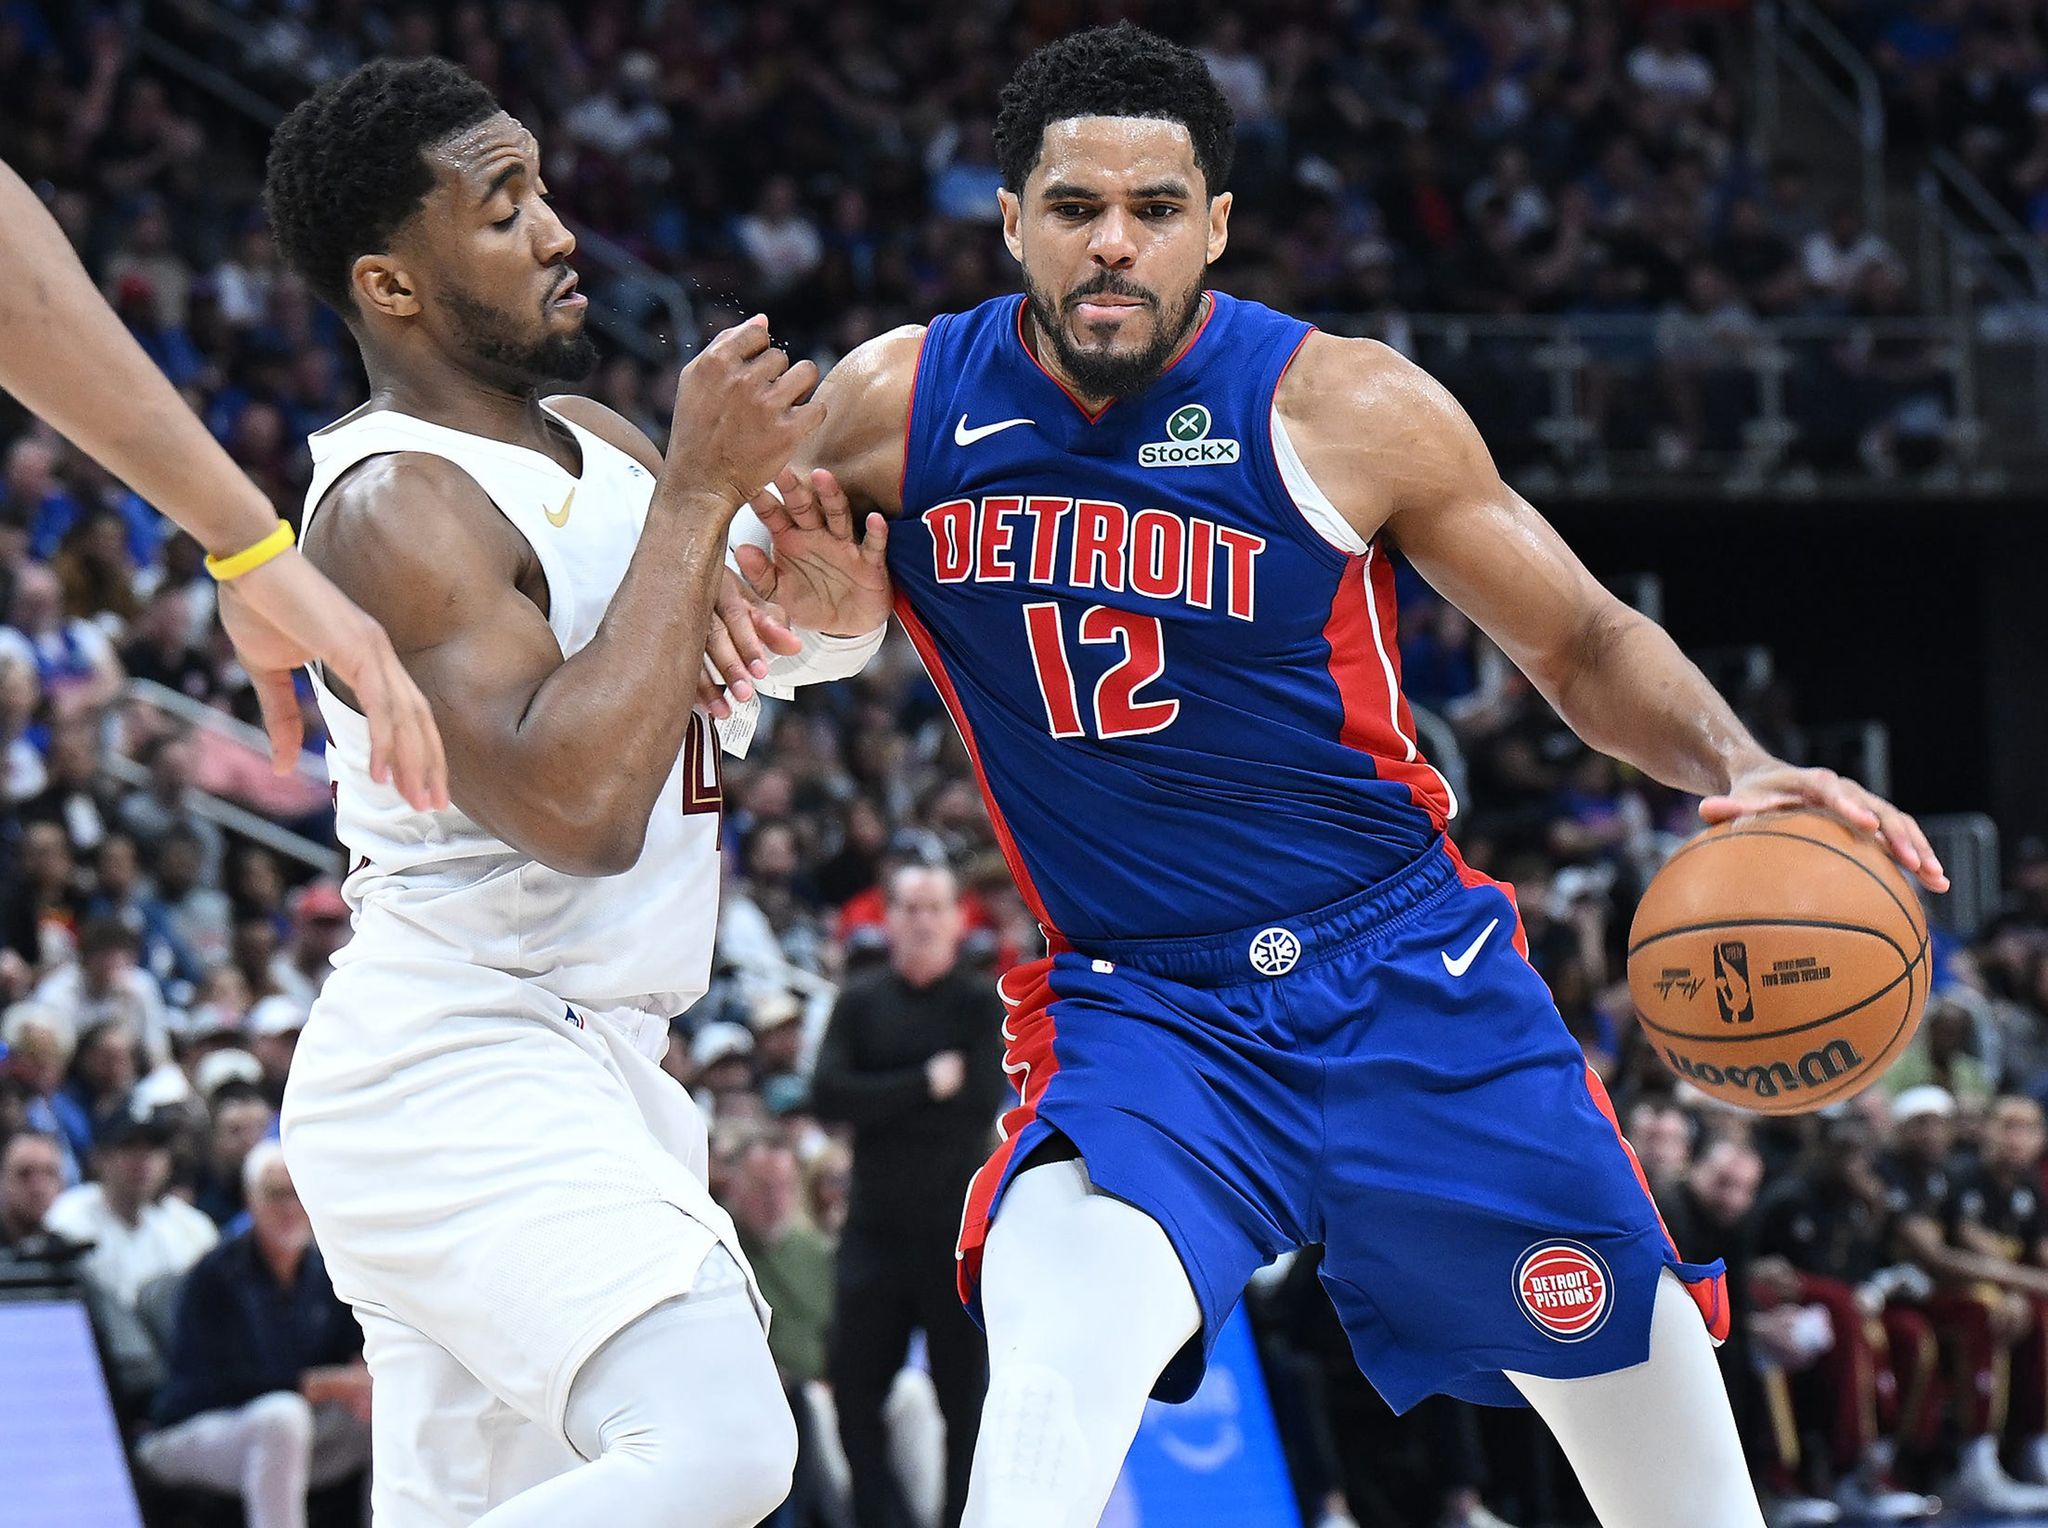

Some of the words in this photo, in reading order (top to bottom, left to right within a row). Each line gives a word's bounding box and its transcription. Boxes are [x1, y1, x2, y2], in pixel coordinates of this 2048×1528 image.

[1141, 442, 1235, 463] StockX
[921, 495, 1266, 622] DETROIT
[1023, 601, 1180, 740] 12
[1663, 1039, 1865, 1097] Wilson
[1529, 1270, 1589, 1292] DETROIT
[1533, 1286, 1594, 1308] PISTONS
